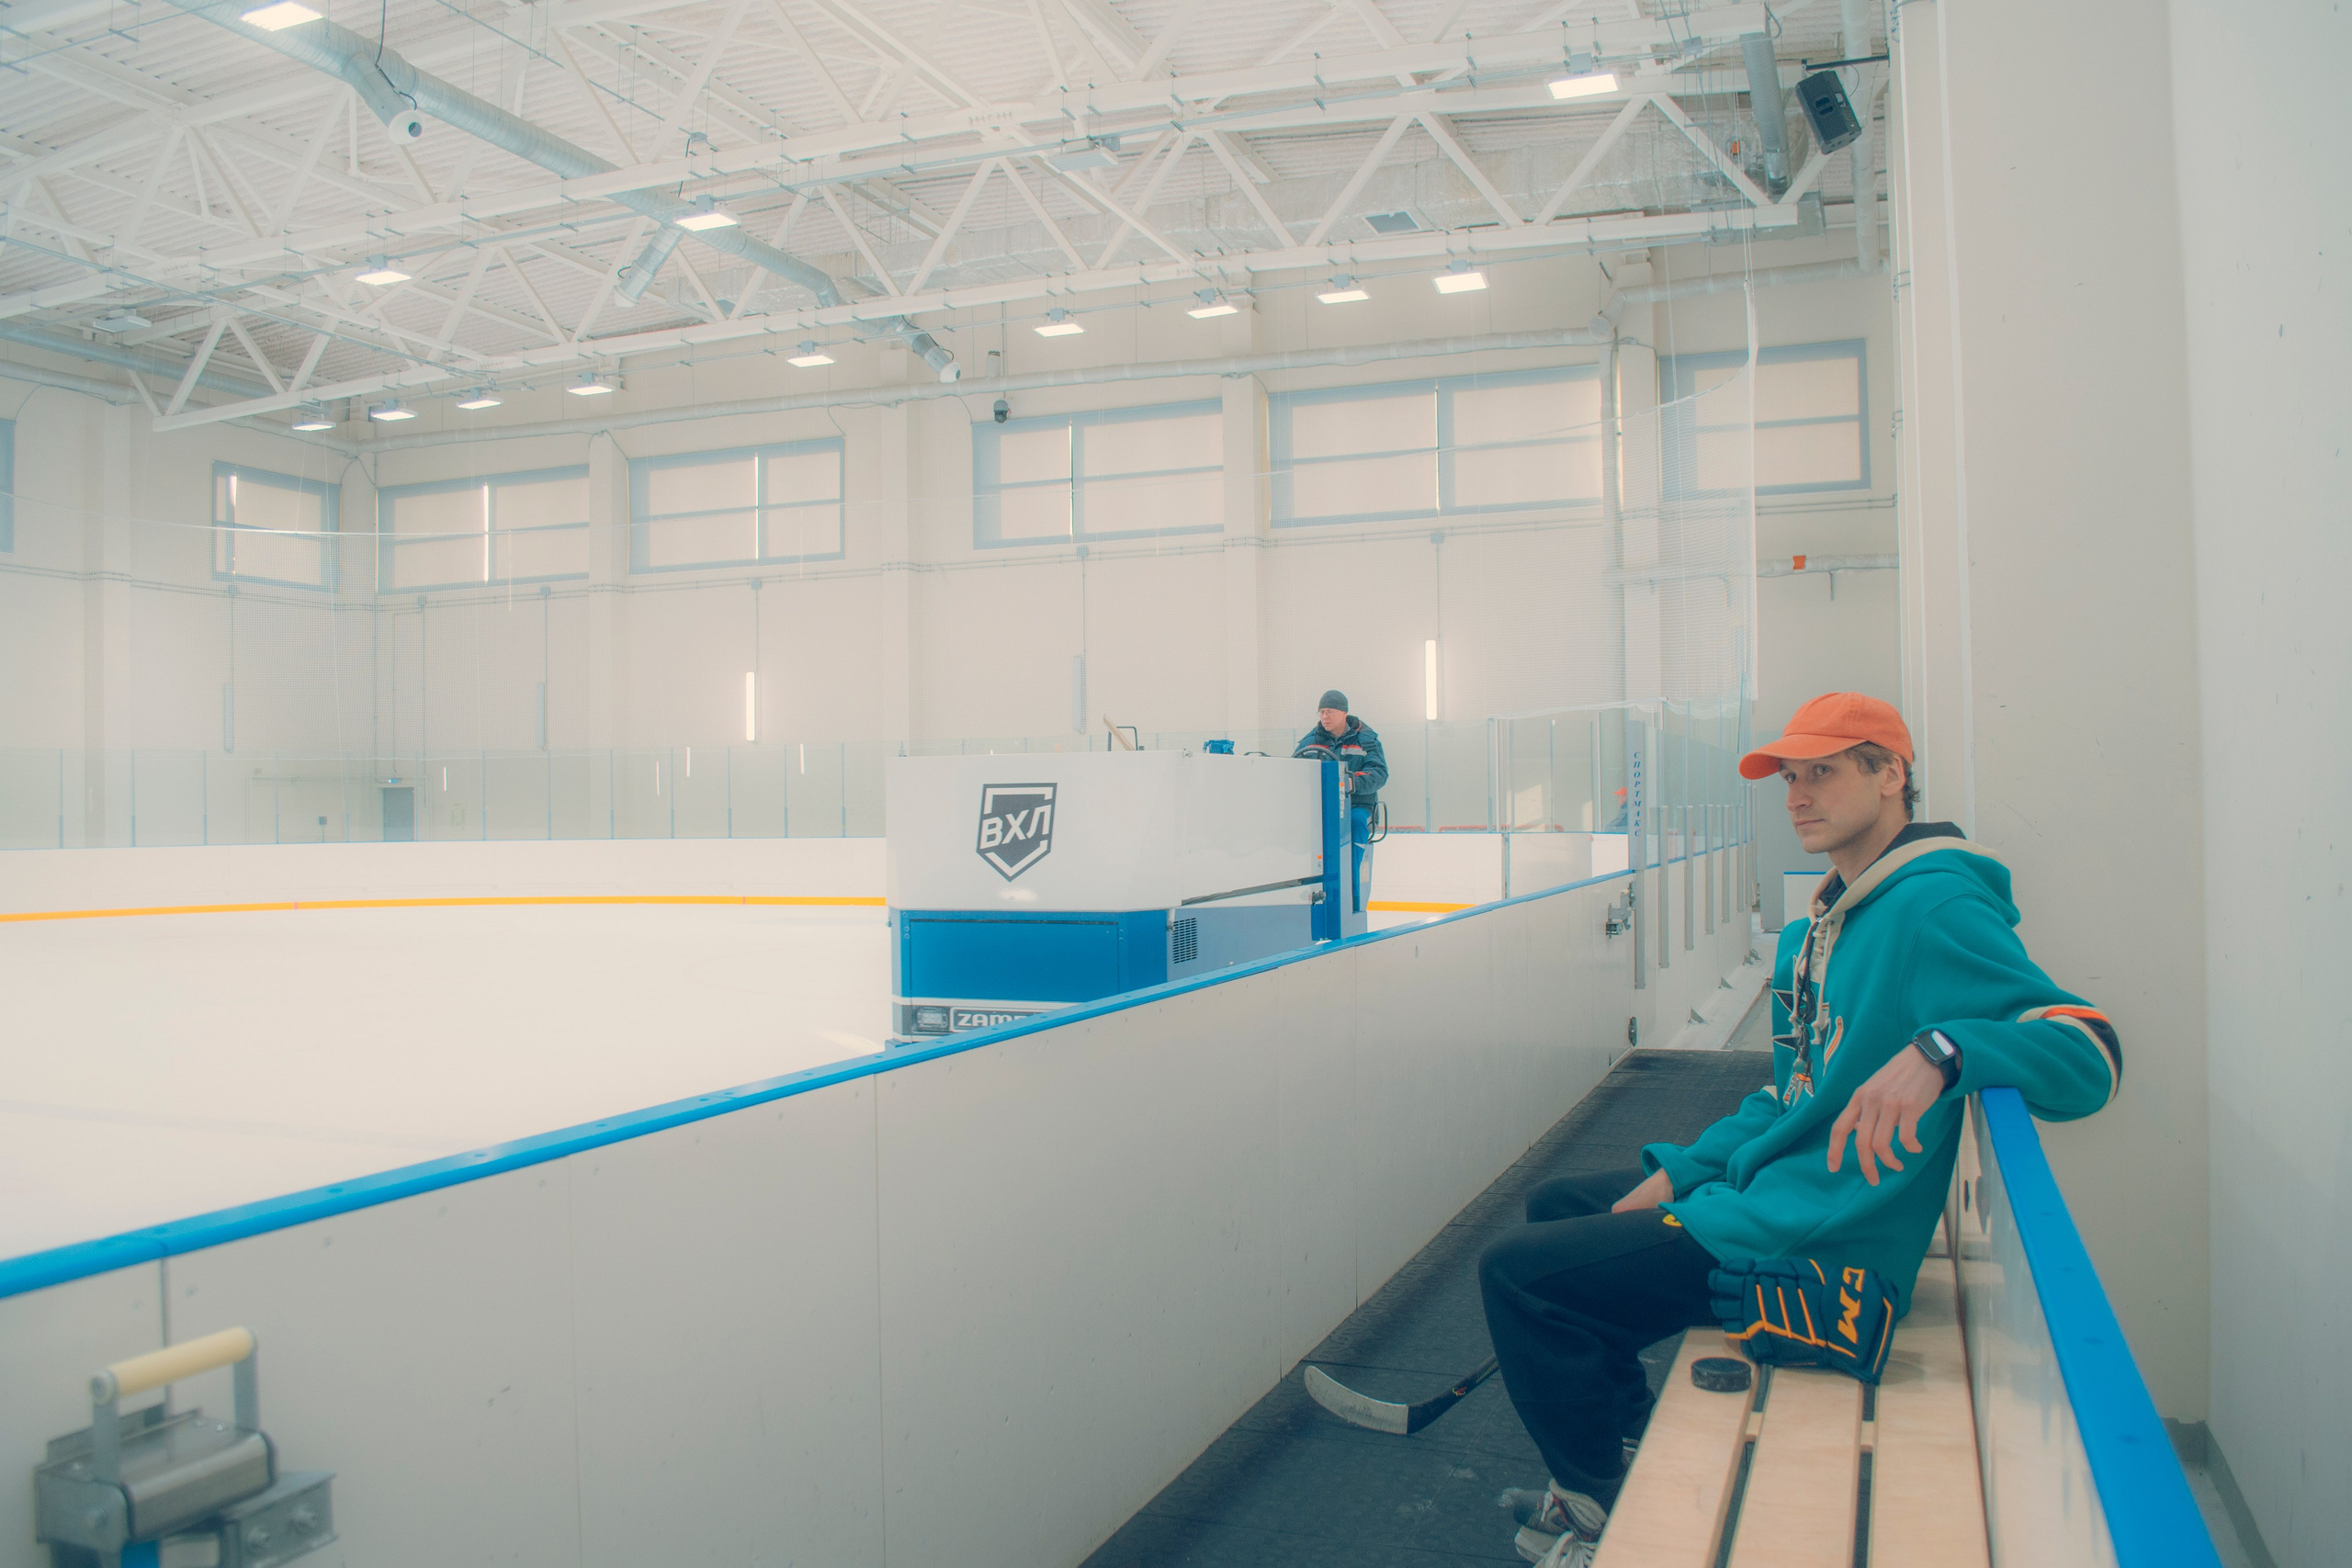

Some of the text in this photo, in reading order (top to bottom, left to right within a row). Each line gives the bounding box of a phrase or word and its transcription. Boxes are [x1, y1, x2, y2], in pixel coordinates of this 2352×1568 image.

[1633, 750, 1642, 838] СПОРТМАКС
[979, 804, 1052, 850] ВХЛ
[957, 1013, 1028, 1027] ZAM
